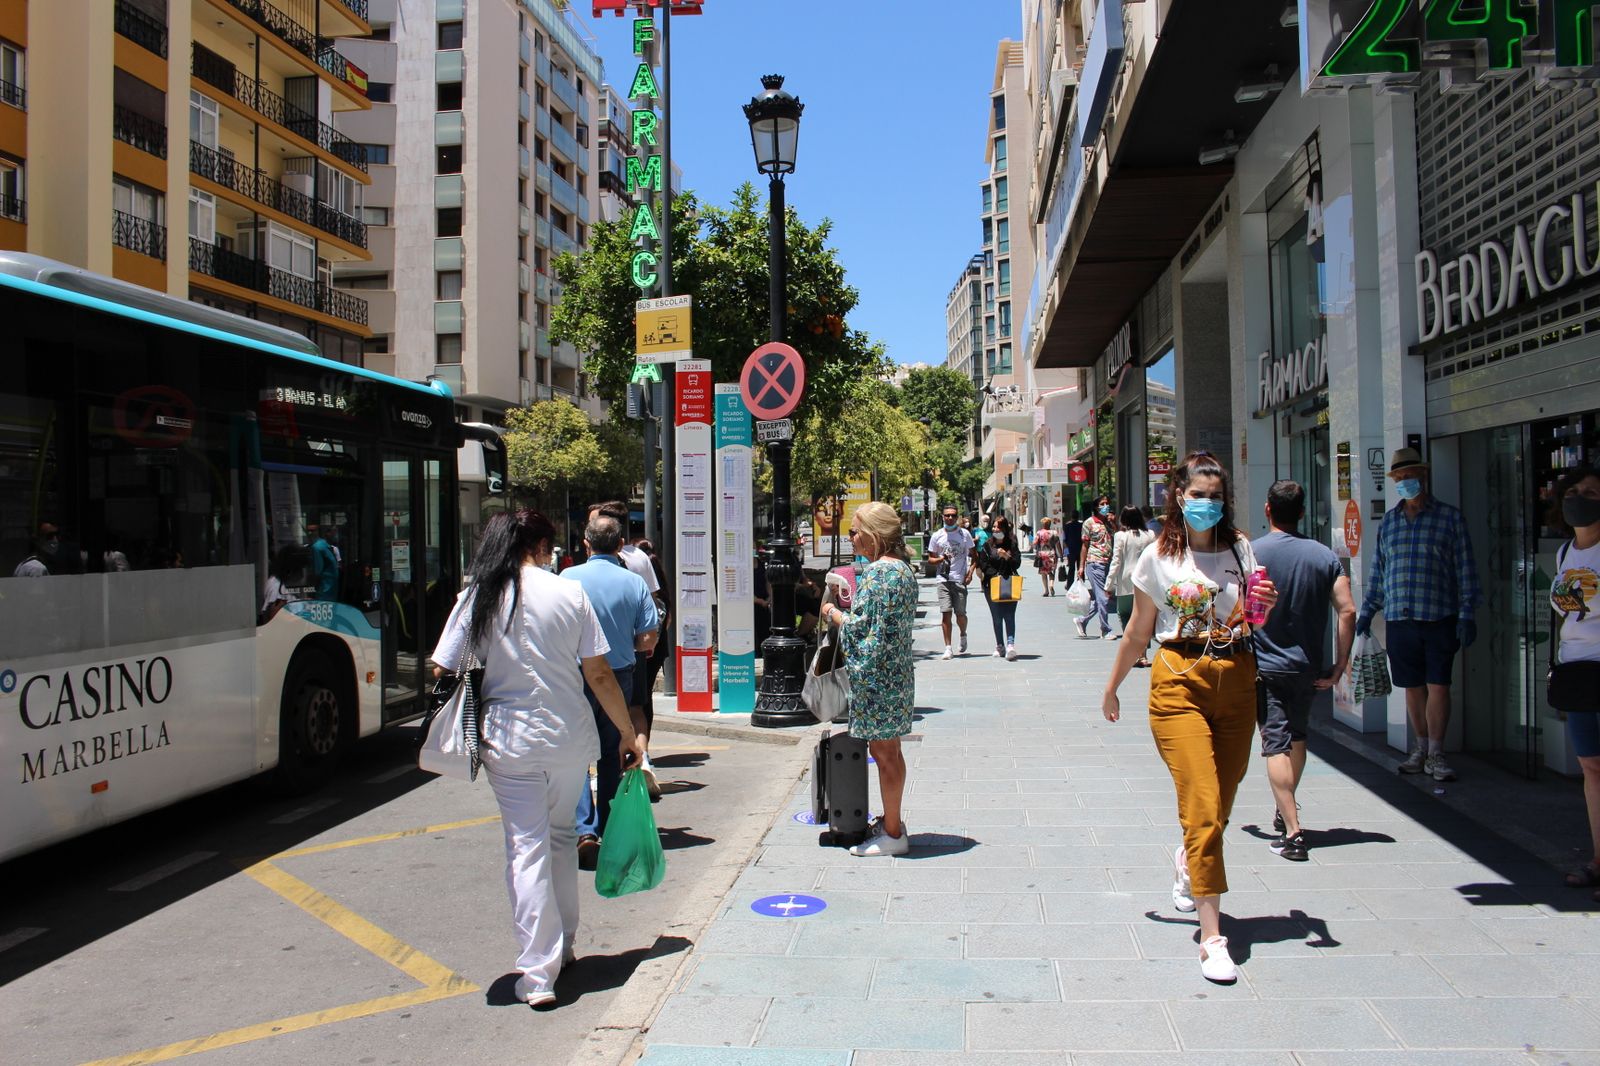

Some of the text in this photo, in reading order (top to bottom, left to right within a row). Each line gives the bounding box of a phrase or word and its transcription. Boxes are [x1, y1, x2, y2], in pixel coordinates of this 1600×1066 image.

[625, 17, 663, 384] FARMACA
[637, 297, 688, 310] BUS ESCOLAR
[1258, 333, 1328, 411] FARMACIA
[276, 387, 284, 402] 3
[285, 387, 315, 406] BANUS
[323, 393, 335, 408] EL
[401, 410, 427, 424] avanza
[758, 422, 787, 431] EXCEPTO
[766, 430, 780, 438] BUS
[1347, 518, 1358, 541] 7€
[19, 656, 173, 730] CASINO
[21, 720, 171, 784] MARBELLA
